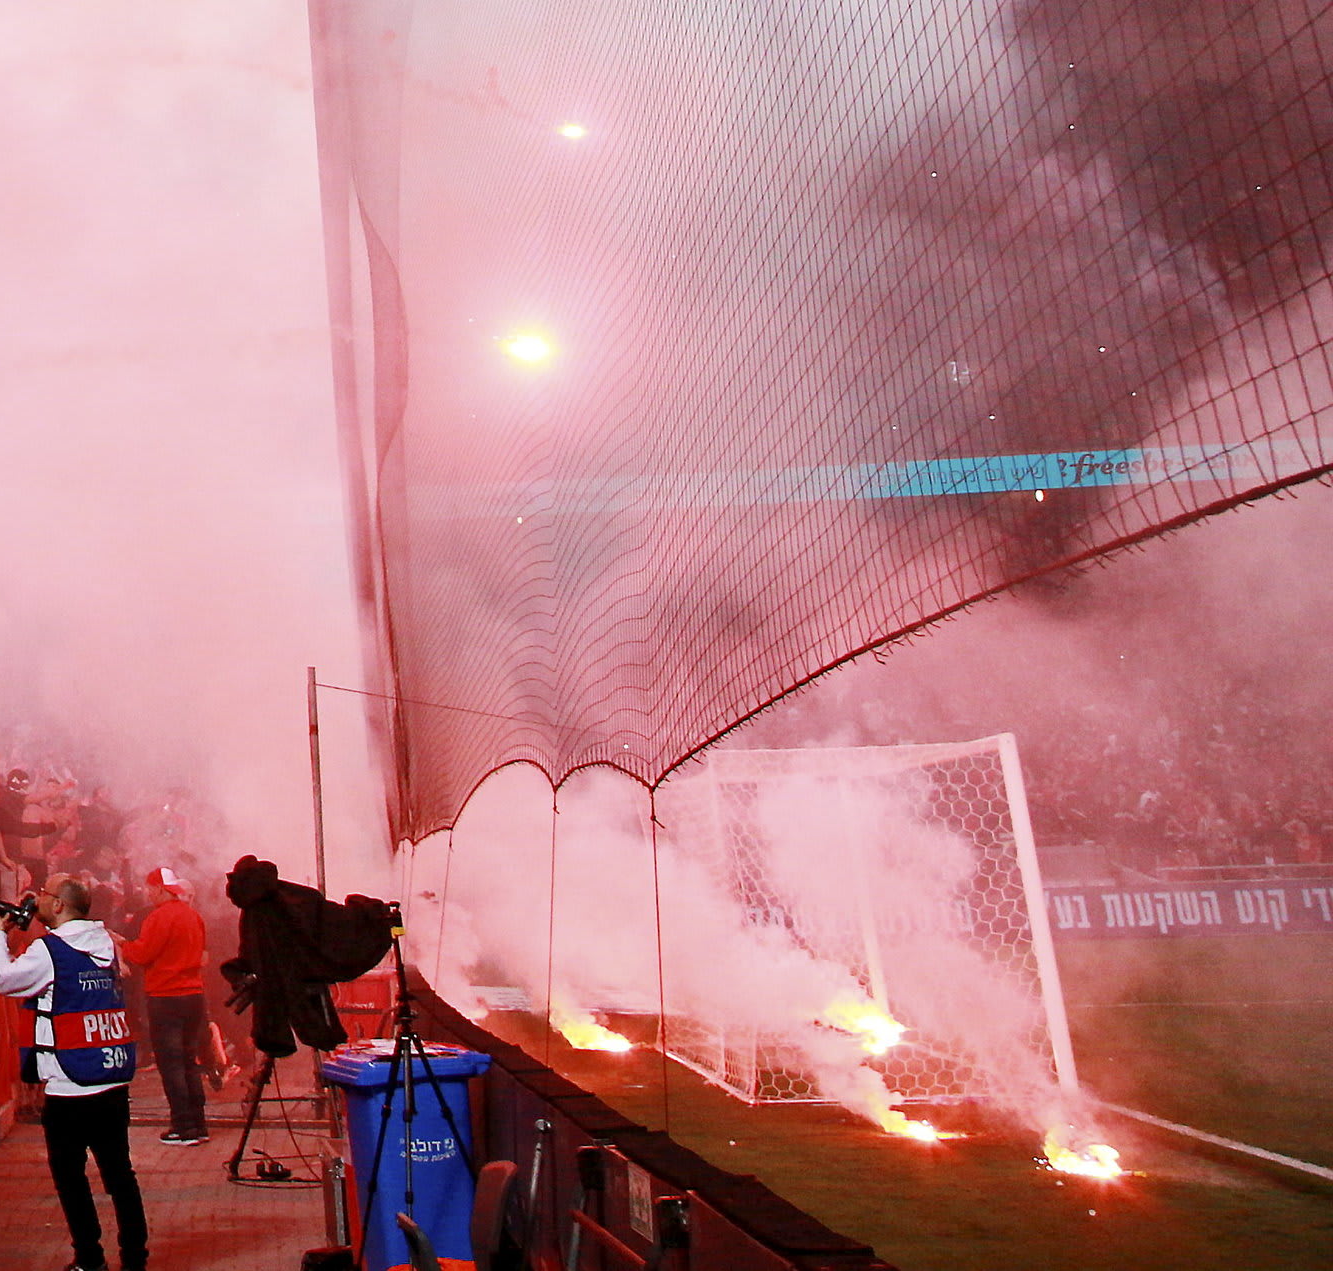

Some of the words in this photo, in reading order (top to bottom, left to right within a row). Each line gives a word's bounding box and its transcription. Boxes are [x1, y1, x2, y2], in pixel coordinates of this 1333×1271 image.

[1101, 890, 1222, 935] השקעות
[1234, 888, 1289, 931] קנט
[82, 1011, 131, 1043] PHOT
